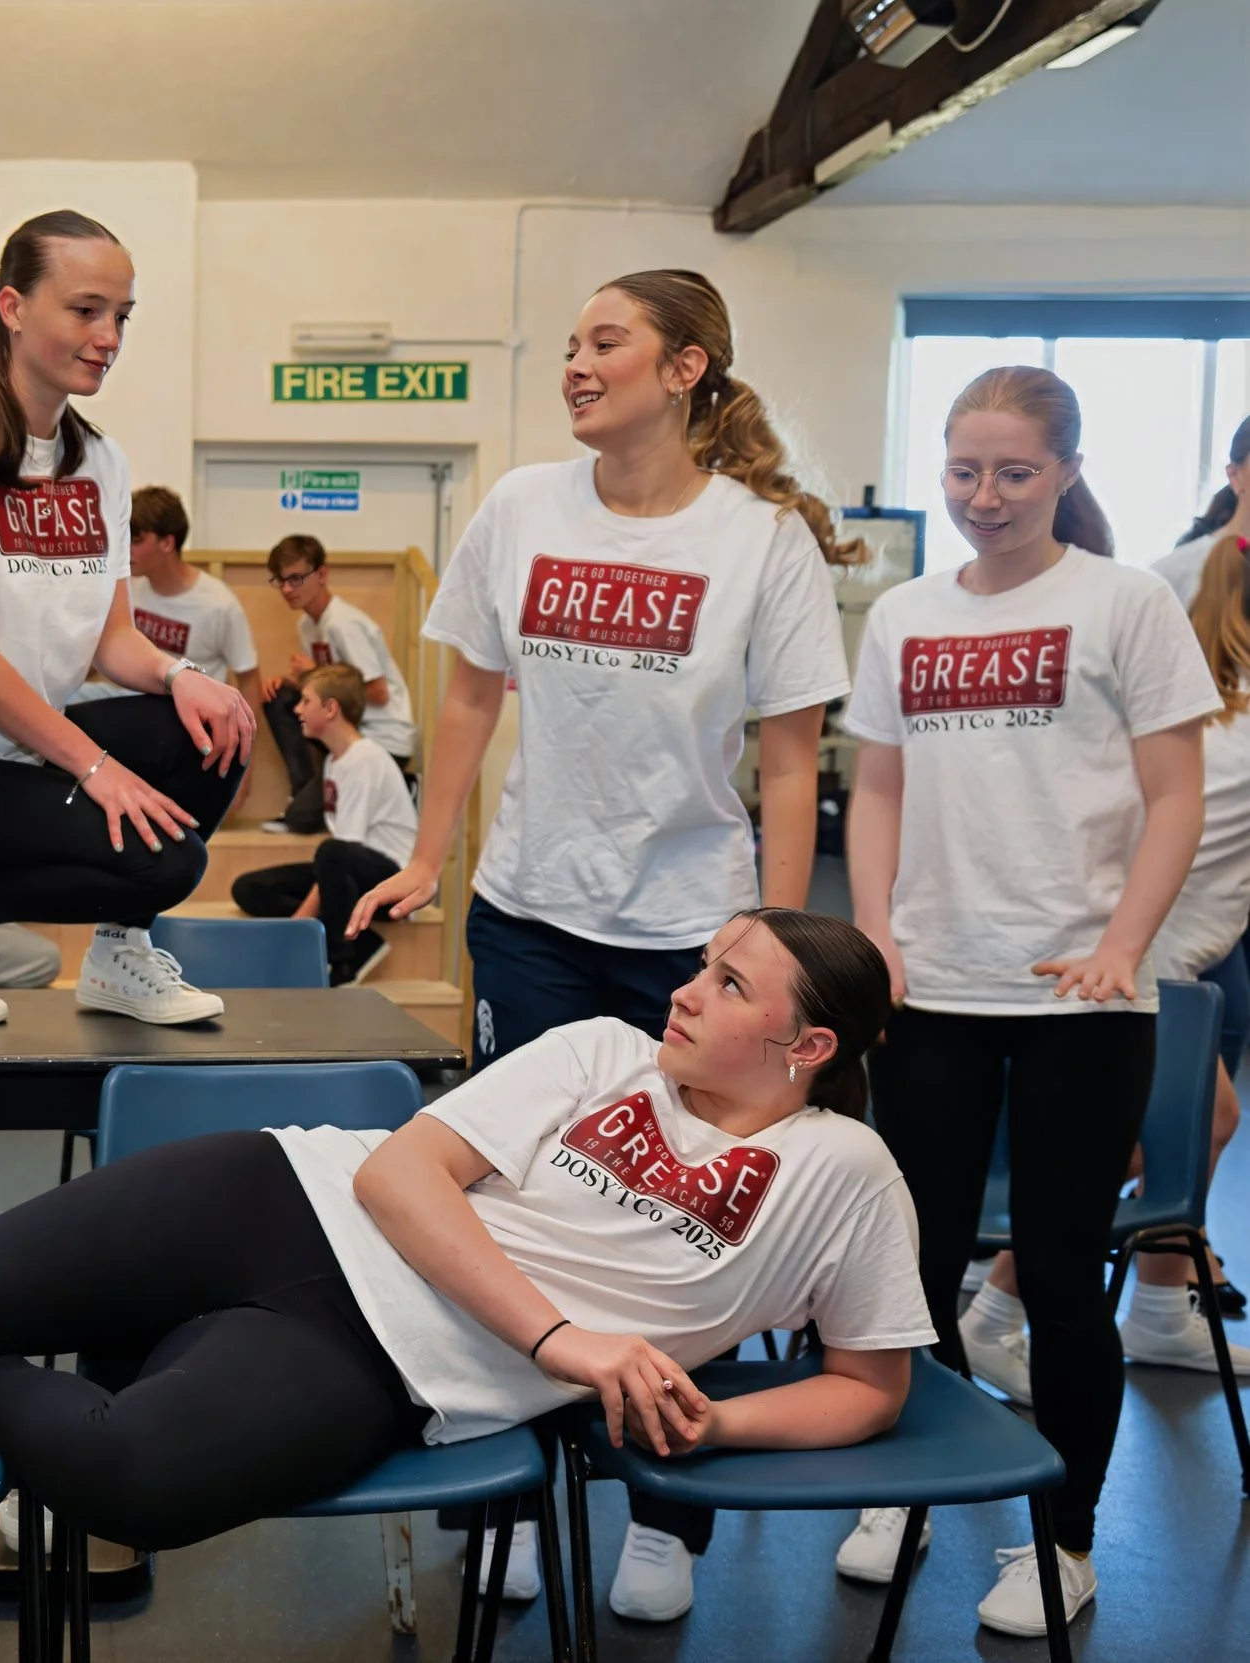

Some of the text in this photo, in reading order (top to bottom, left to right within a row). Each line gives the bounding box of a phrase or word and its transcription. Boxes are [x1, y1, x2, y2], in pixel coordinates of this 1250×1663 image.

[282, 365, 462, 398] FIRE EXIT
[4, 494, 100, 538] GREASE
[40, 541, 88, 553] MUSICAL
[571, 566, 668, 588] WE GO TOGETHER
[538, 577, 692, 631] GREASE
[555, 622, 581, 637] THE
[589, 628, 653, 645] MUSICAL
[521, 640, 680, 674] DOSYTCo 2025
[911, 645, 1055, 693] GREASE
[928, 694, 951, 707] THE
[960, 690, 1022, 705] MUSICAL
[1005, 709, 1053, 727] 2025
[644, 1119, 669, 1160] WE GO
[597, 1105, 760, 1215] GRESE
[583, 1138, 734, 1232] 19 THE MSICAL 59
[550, 1149, 663, 1223] DOSYTCo
[670, 1217, 727, 1261] 2025
